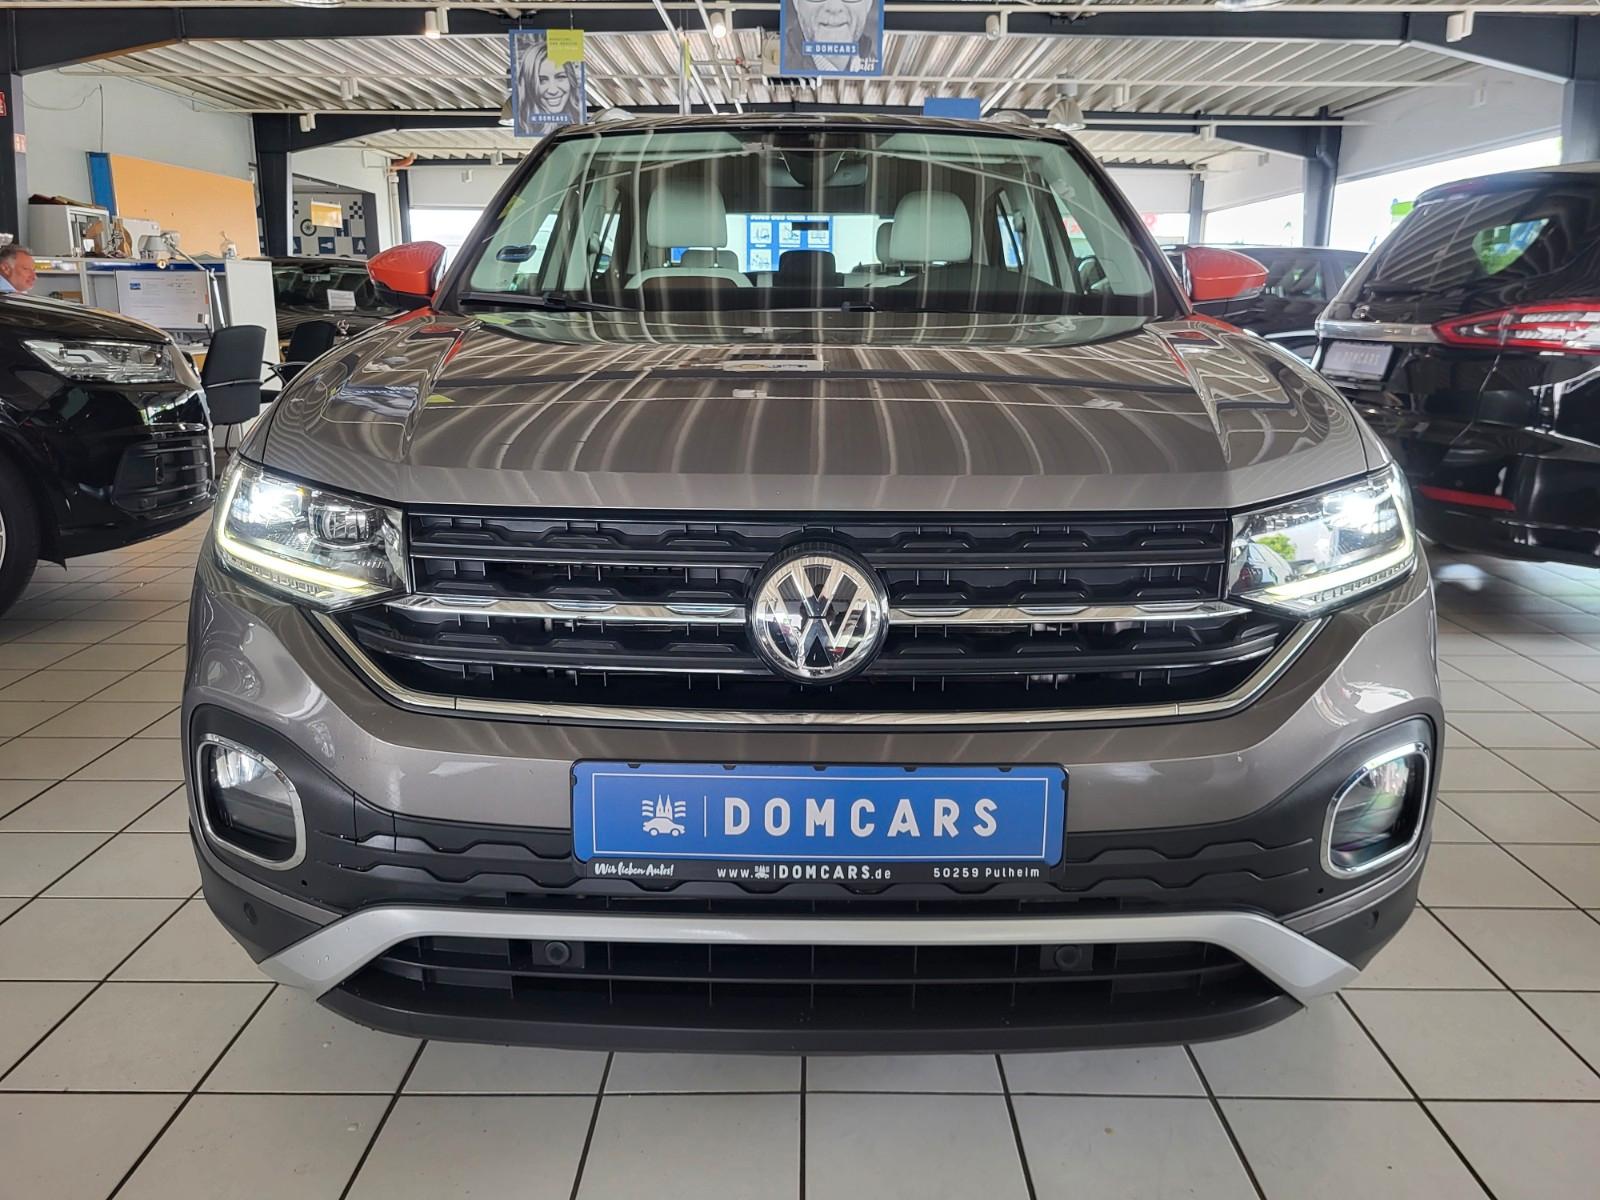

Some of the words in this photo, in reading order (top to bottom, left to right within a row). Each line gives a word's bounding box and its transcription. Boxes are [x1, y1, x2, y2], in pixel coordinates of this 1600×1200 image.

[754, 556, 879, 678] VW
[724, 797, 998, 838] DOMCARS
[594, 862, 617, 876] Wir
[618, 861, 646, 877] lieben
[646, 863, 675, 877] Autos!
[933, 867, 979, 879] 50259
[985, 867, 1040, 878] Pulheim
